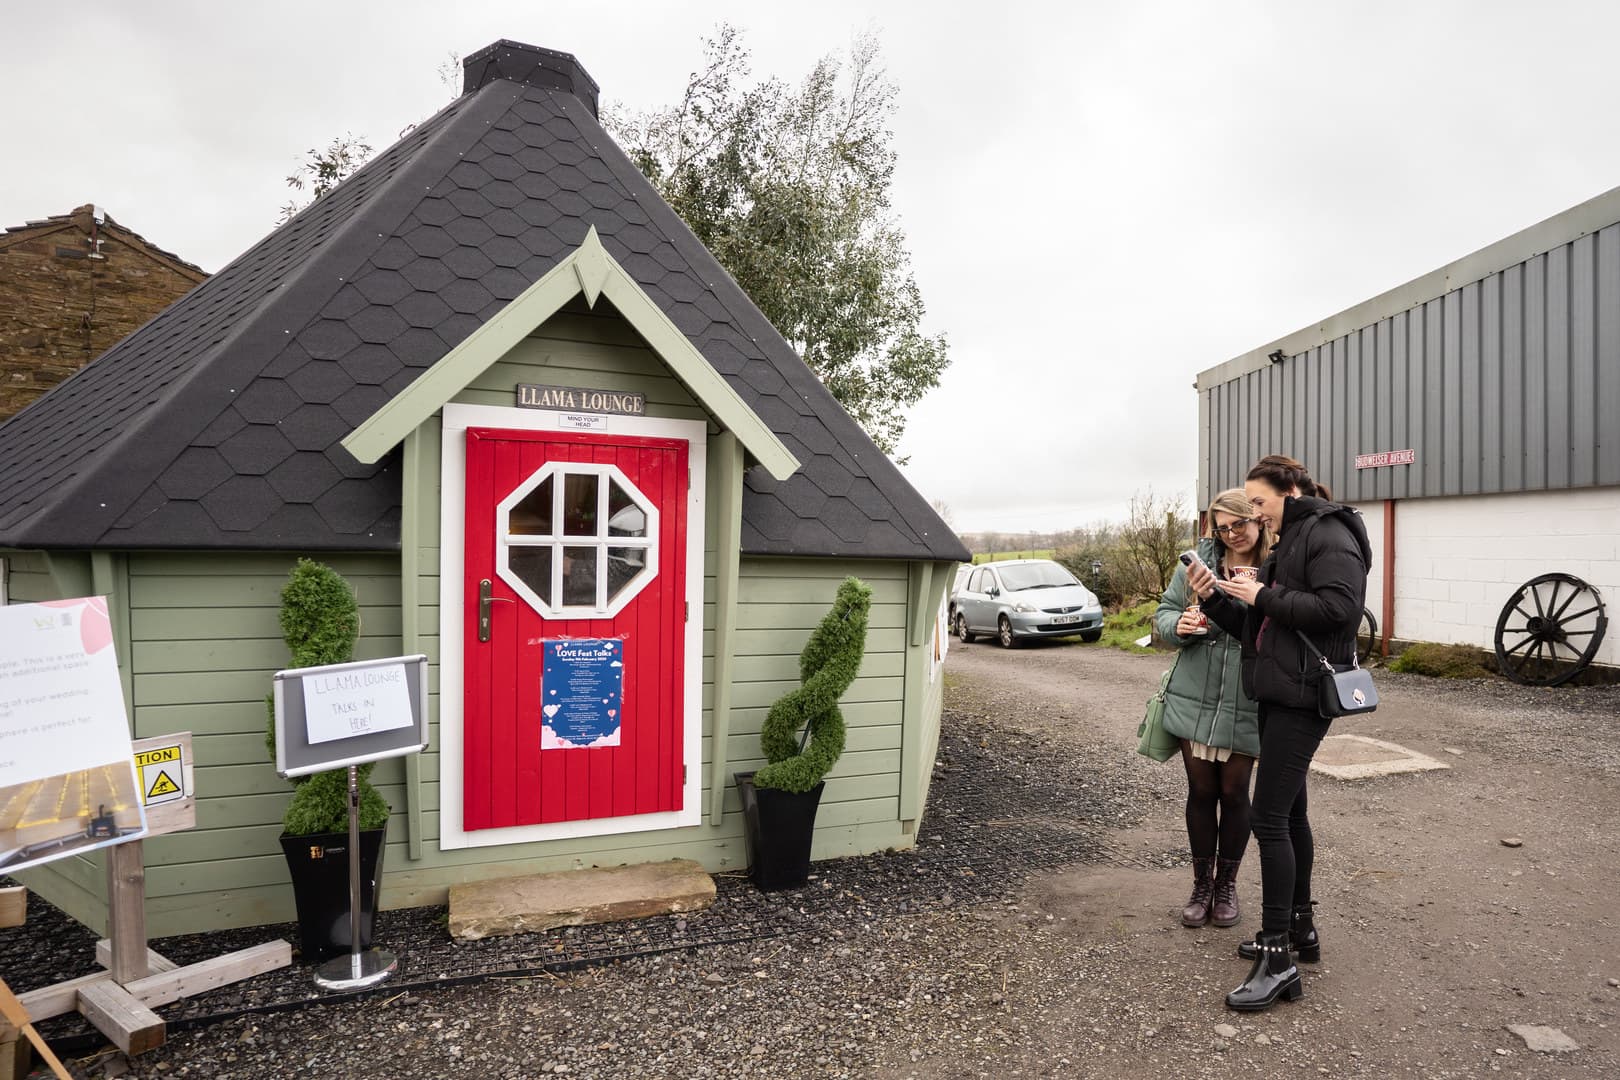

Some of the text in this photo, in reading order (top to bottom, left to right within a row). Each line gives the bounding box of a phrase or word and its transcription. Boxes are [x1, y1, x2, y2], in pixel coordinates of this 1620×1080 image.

[521, 387, 642, 413] LLAMA LOUNGE
[1391, 451, 1411, 463] AVENUE
[577, 649, 592, 657] Fest
[593, 649, 612, 657] Talks
[314, 670, 400, 695] LLAMA LOUNGE
[332, 702, 358, 715] TALKS
[137, 749, 173, 765] TION
